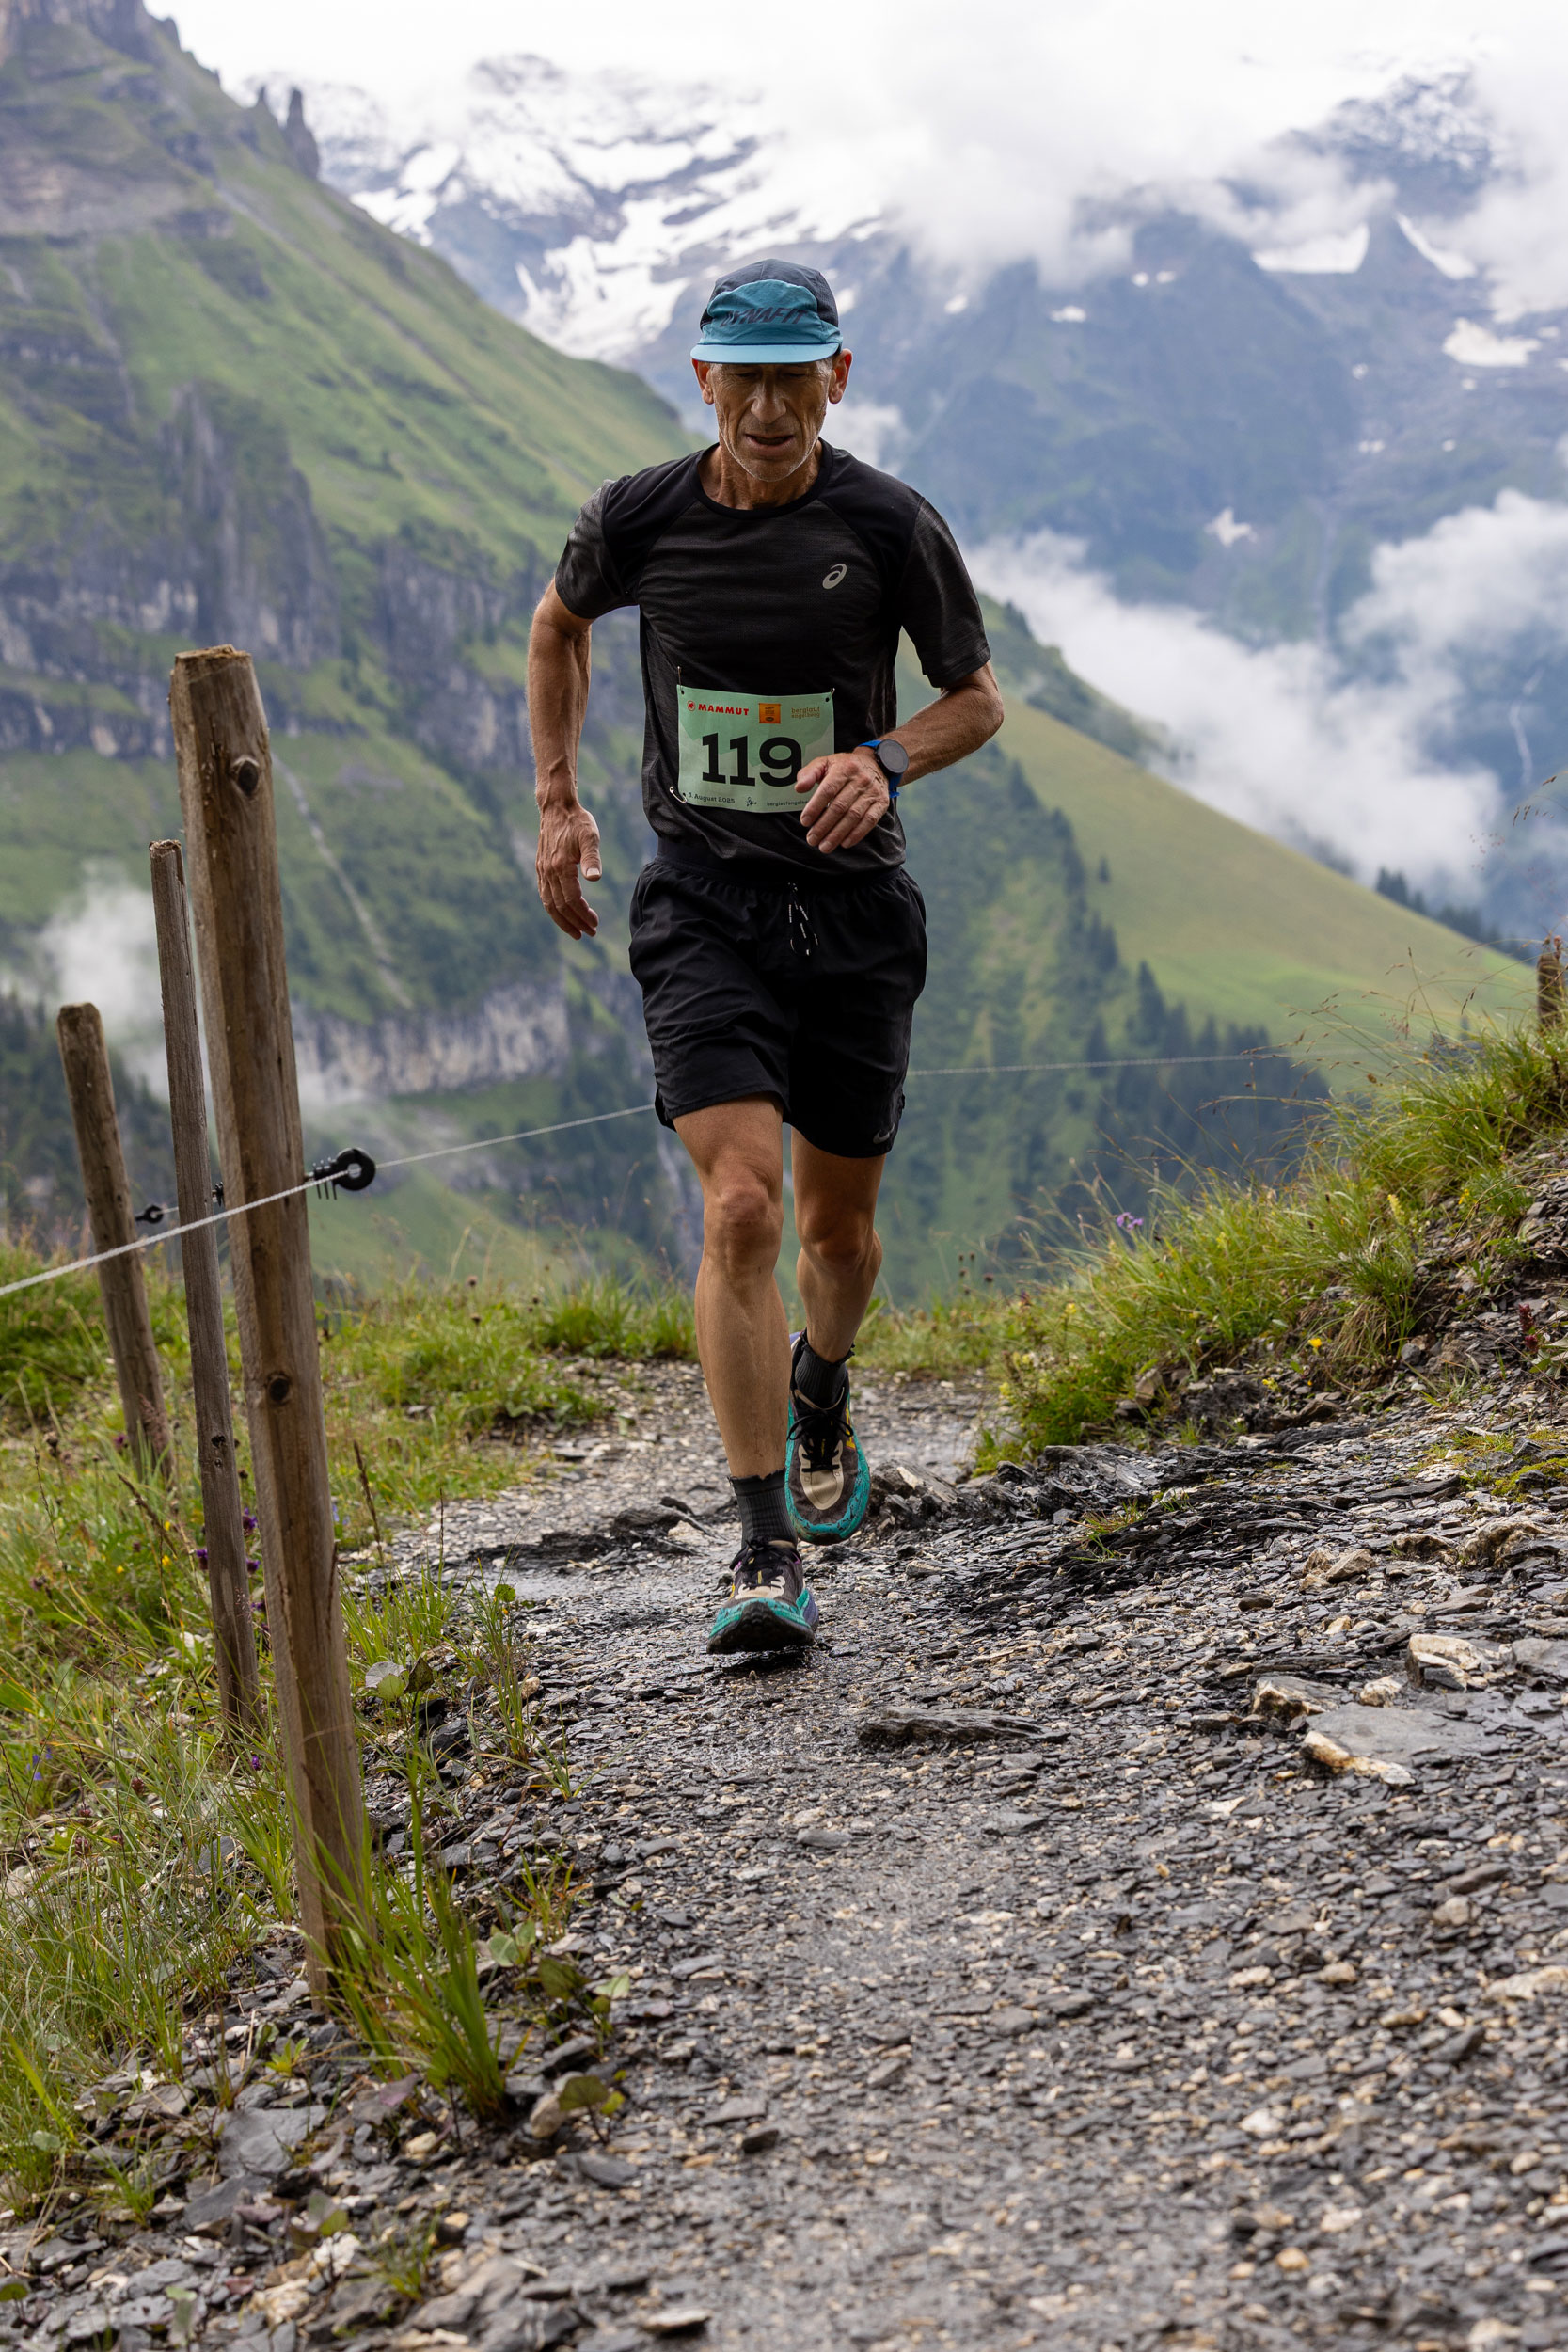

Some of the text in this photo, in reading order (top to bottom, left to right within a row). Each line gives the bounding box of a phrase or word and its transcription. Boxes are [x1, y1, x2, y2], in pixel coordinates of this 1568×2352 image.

[720, 307, 809, 327] DYNAFIT
[698, 703, 750, 716] MAMMUT
[791, 706, 820, 714] berglauf
[702, 733, 802, 787] 119
[694, 793, 717, 803] August
